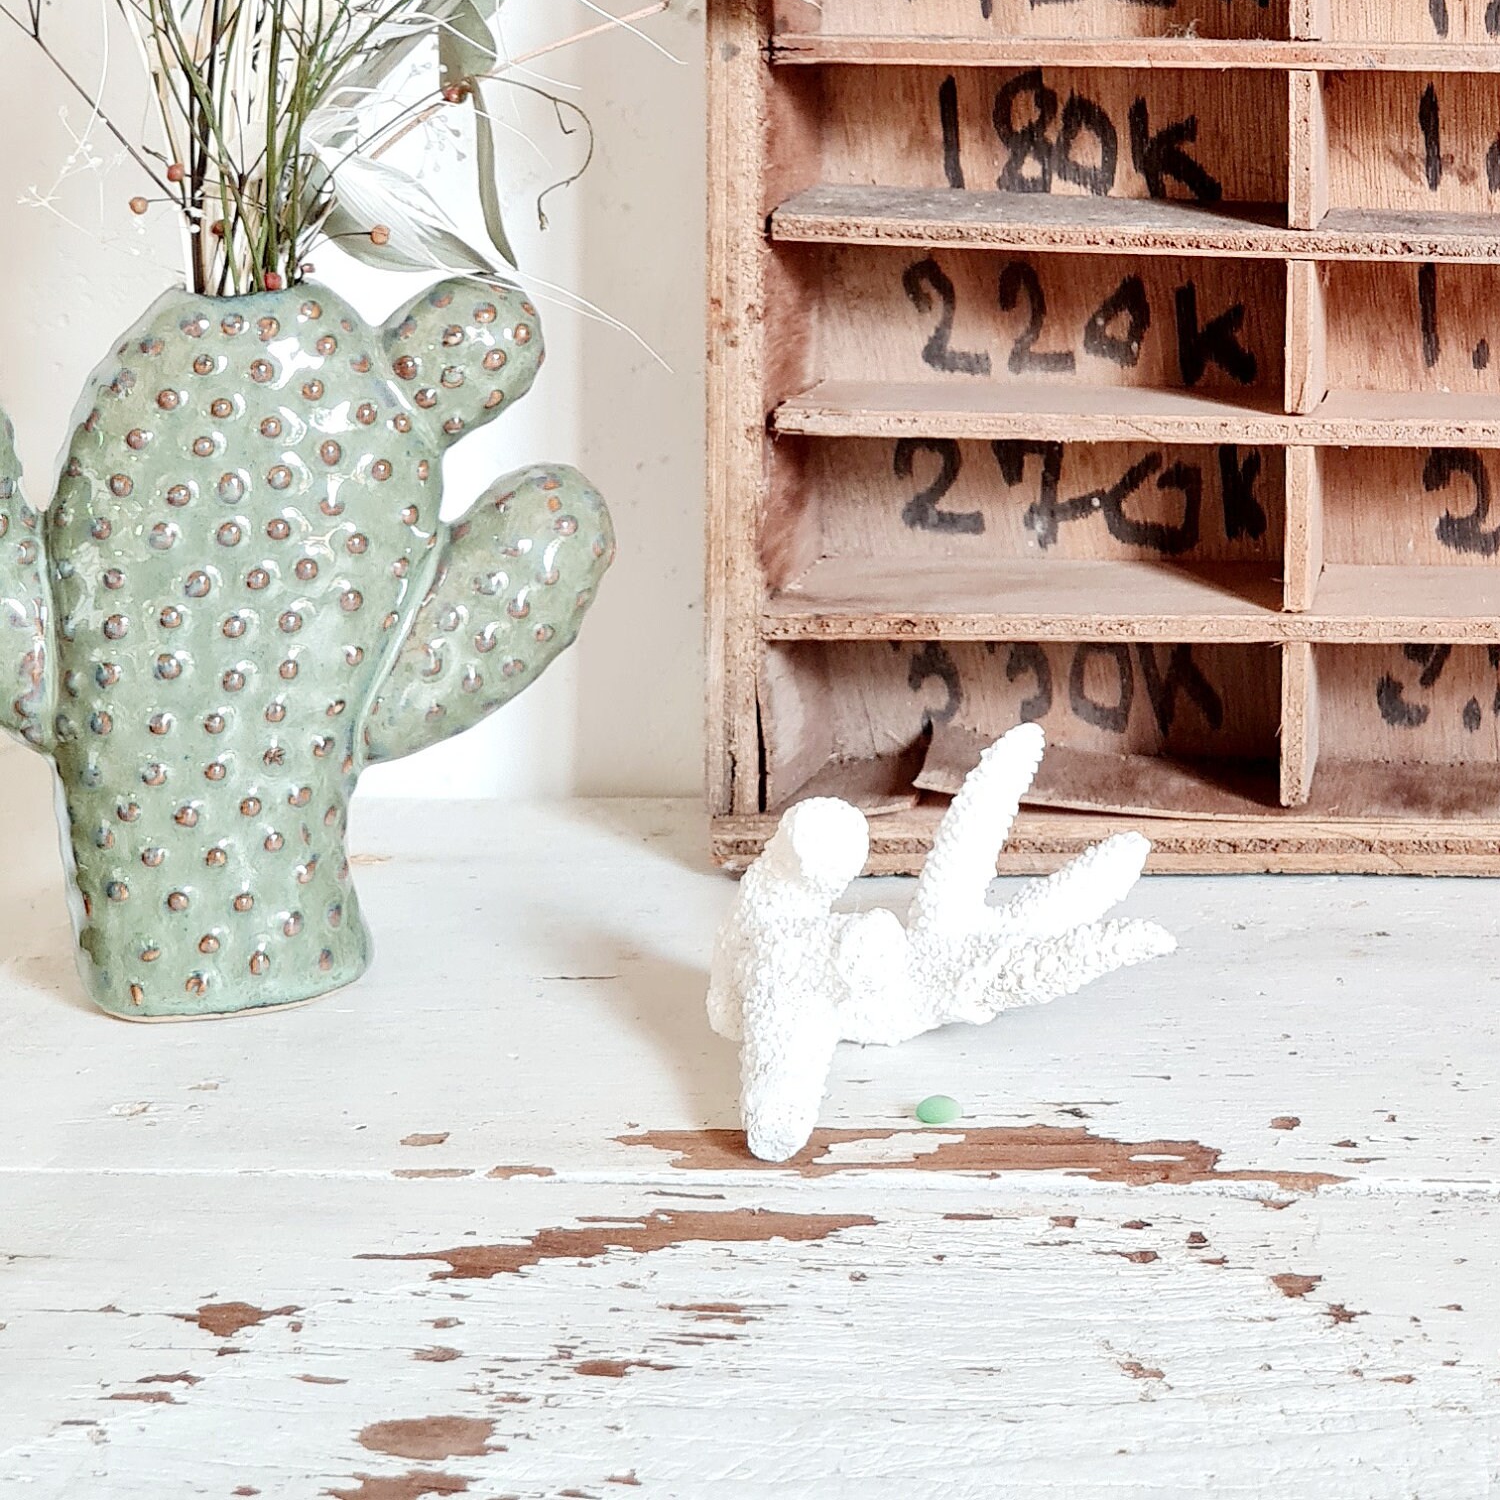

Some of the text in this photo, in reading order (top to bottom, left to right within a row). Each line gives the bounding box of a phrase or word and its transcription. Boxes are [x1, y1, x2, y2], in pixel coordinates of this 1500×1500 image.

[938, 69, 1222, 199] 180K
[902, 258, 1257, 386] 220K
[894, 438, 1269, 556] 270K
